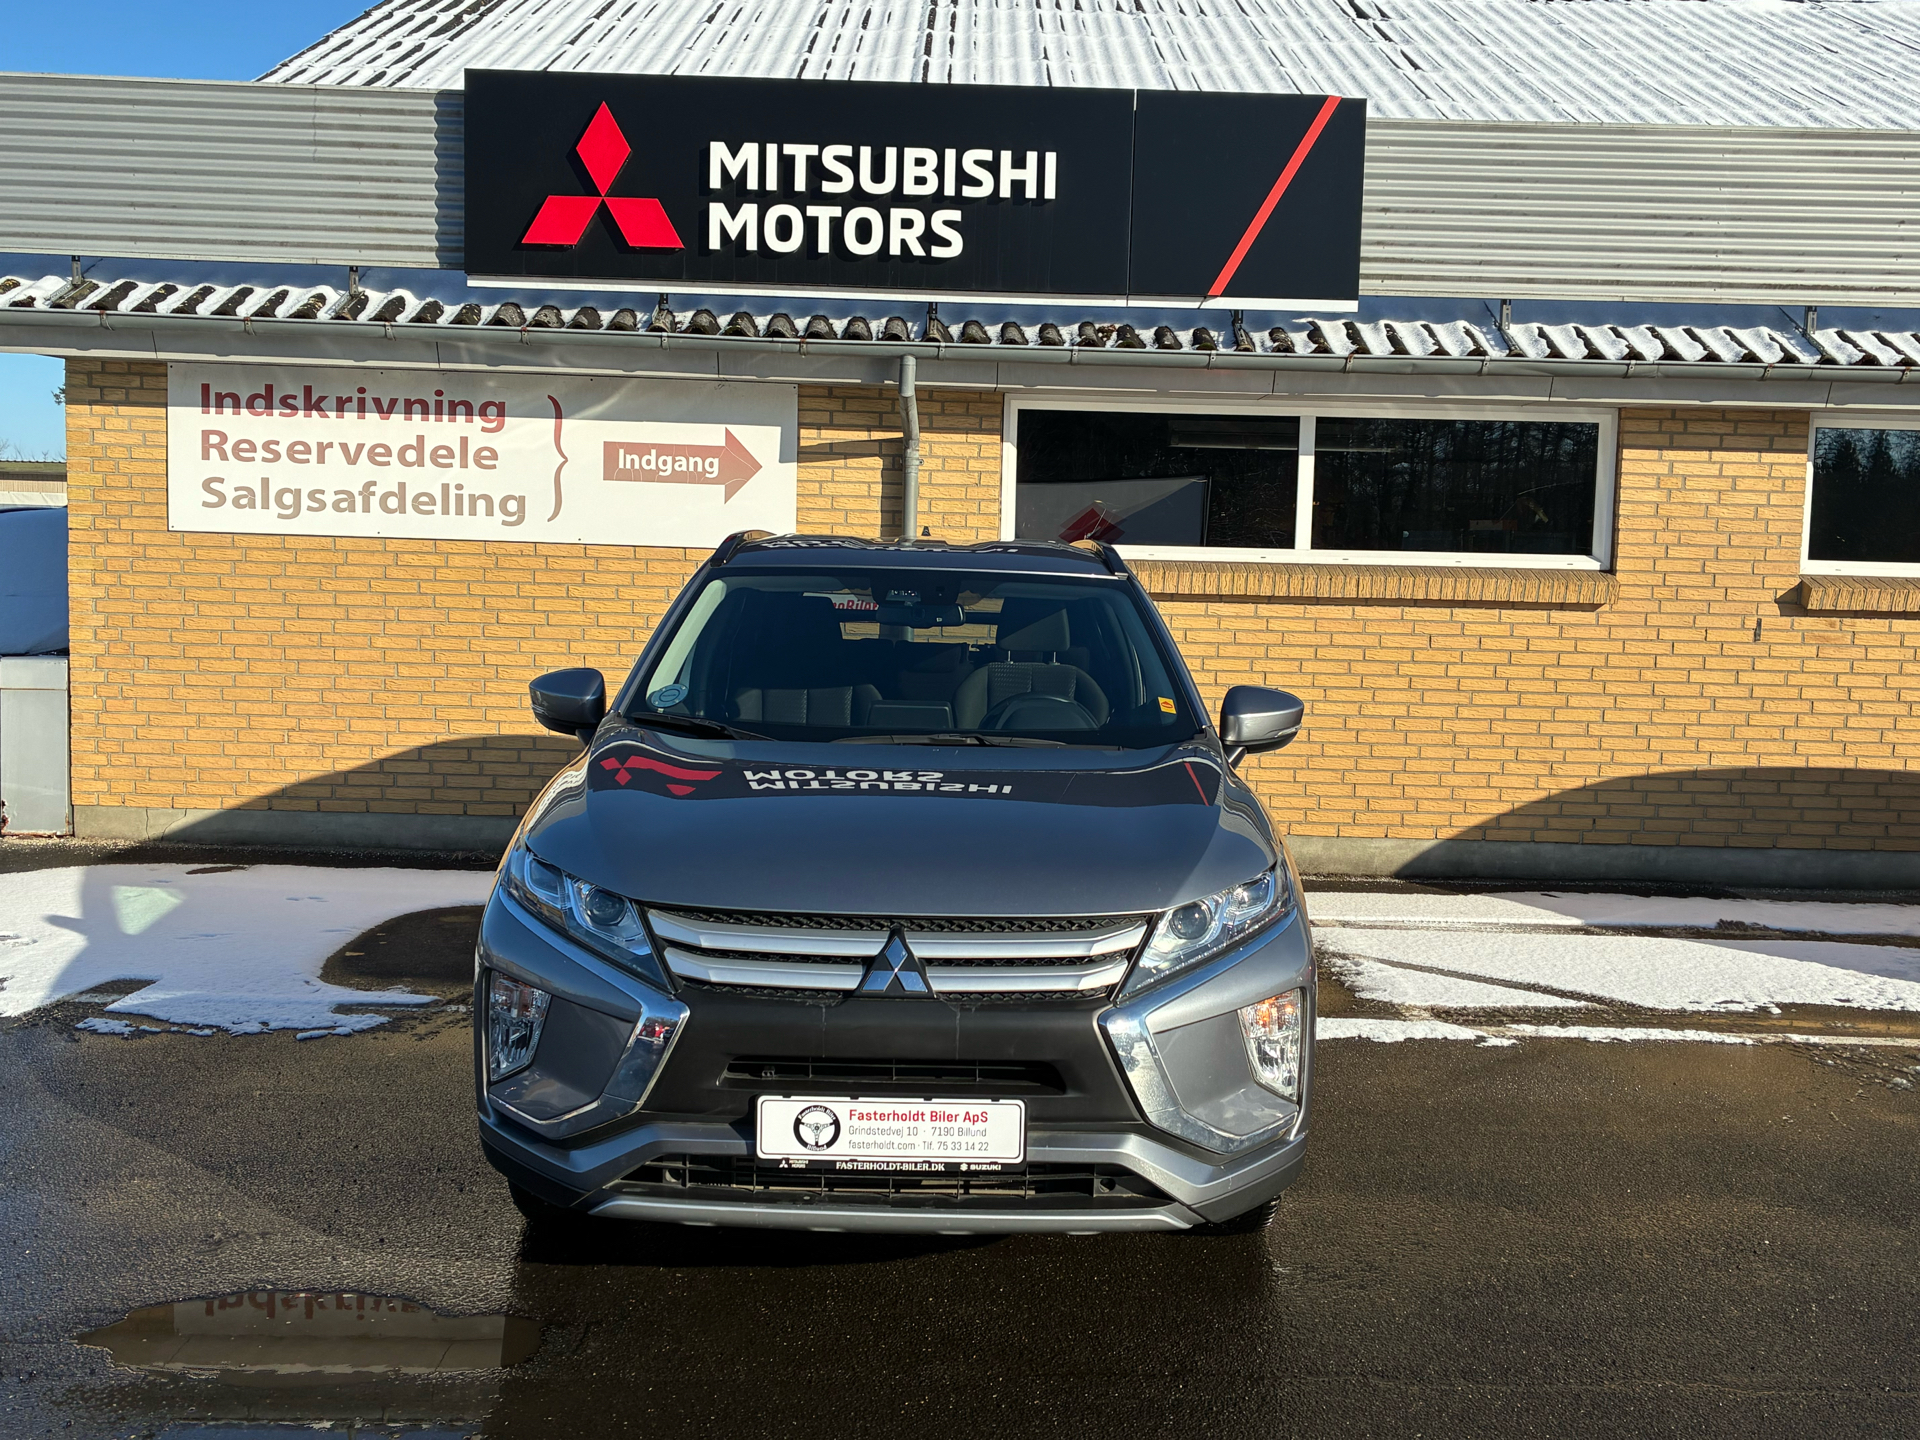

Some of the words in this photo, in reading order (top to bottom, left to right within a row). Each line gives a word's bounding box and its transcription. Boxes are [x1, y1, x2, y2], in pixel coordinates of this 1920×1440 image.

[709, 141, 1057, 200] MITSUBISHI
[708, 202, 964, 258] MOTORS
[200, 382, 506, 432] Indskrivning
[200, 430, 500, 470] Reservedele
[617, 447, 721, 480] Indgang
[200, 477, 527, 527] Salgsafdeling
[848, 1125, 904, 1138] Grindstedvej
[907, 1127, 919, 1137] 10
[931, 1127, 955, 1137] 7190
[958, 1127, 987, 1138] Billund
[849, 1109, 925, 1122] Fasterholdt
[930, 1110, 960, 1123] Biler
[962, 1111, 988, 1126] ApS
[848, 1140, 916, 1151] fasterholdt.com
[937, 1141, 949, 1151] 75
[950, 1141, 962, 1151] 33
[964, 1141, 976, 1151] 14
[977, 1141, 989, 1152] 22
[836, 1161, 946, 1172] FASTERHOLDT-BILER.DK
[969, 1163, 1002, 1171] SUZUKI
